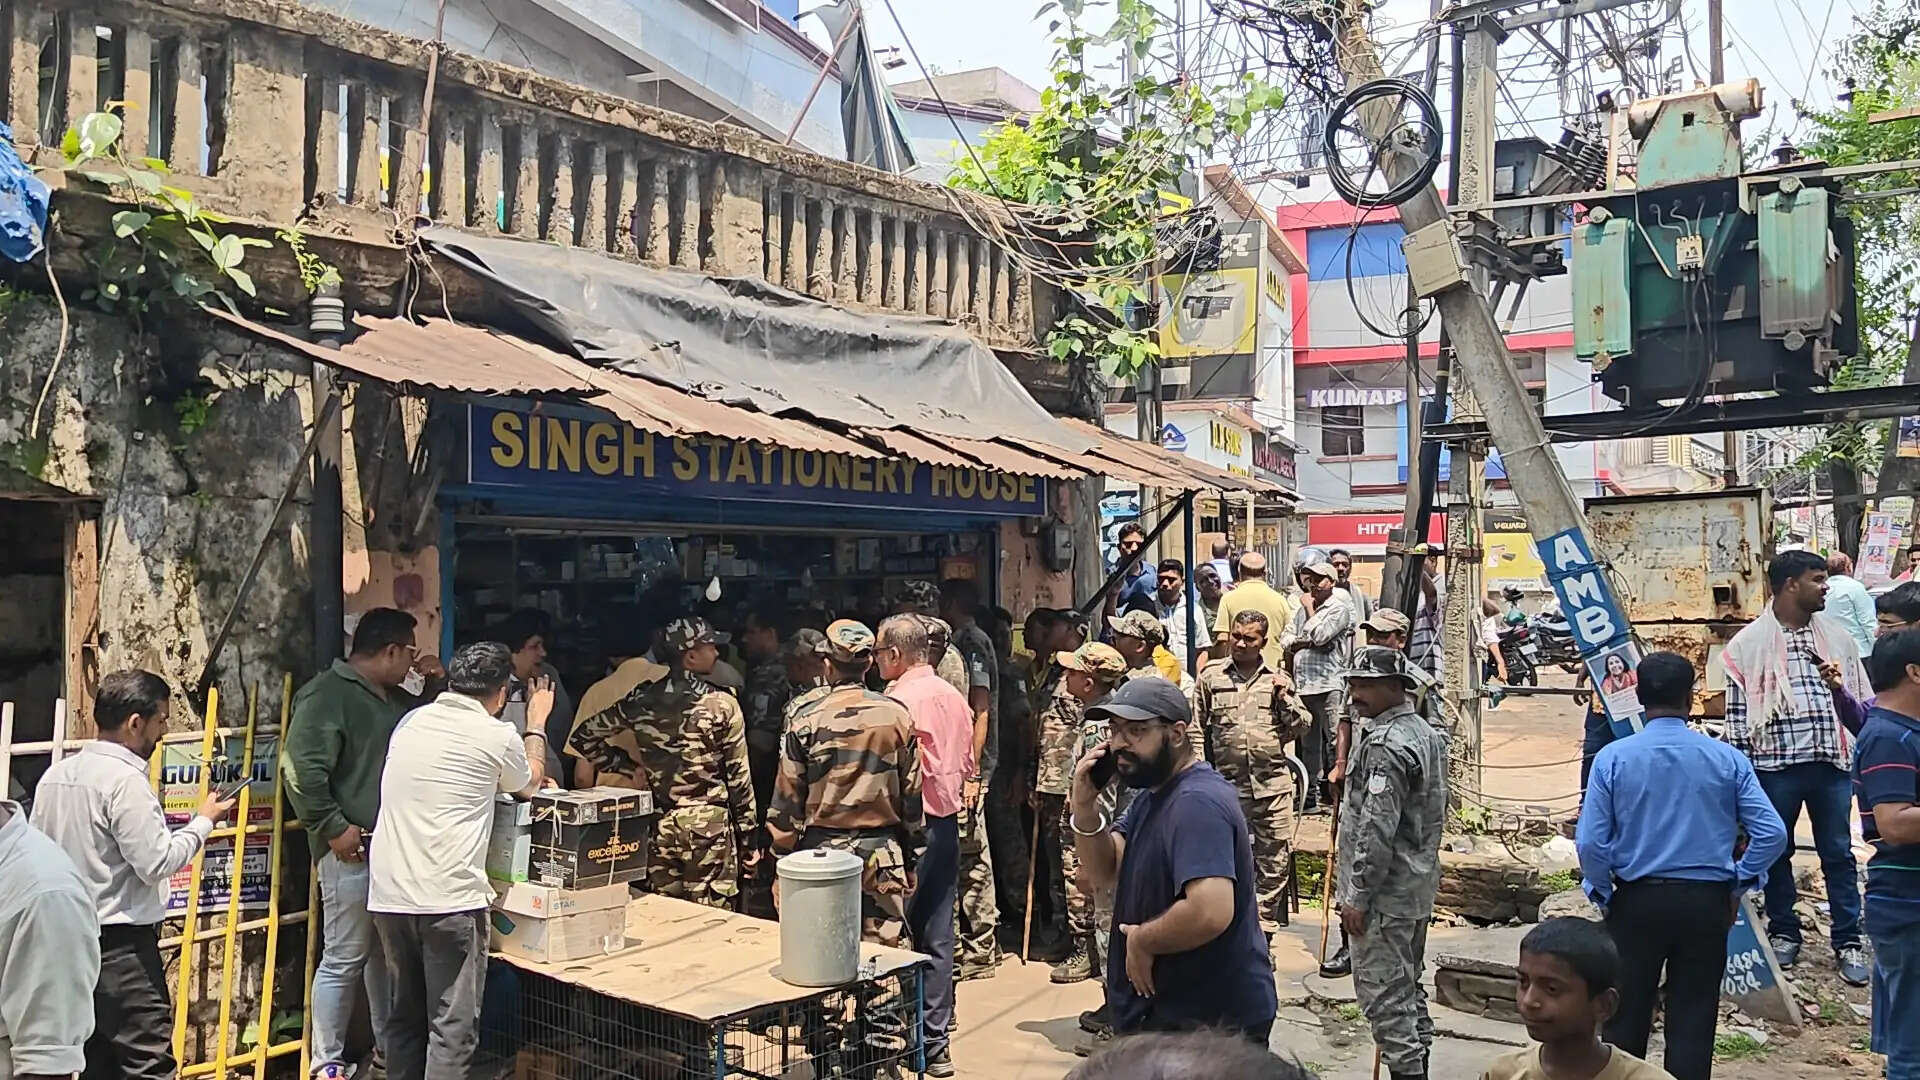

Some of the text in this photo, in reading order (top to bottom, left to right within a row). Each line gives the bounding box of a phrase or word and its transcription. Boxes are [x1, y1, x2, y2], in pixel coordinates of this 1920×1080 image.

[490, 411, 1038, 503] SINGH STATIONERY HOUSE
